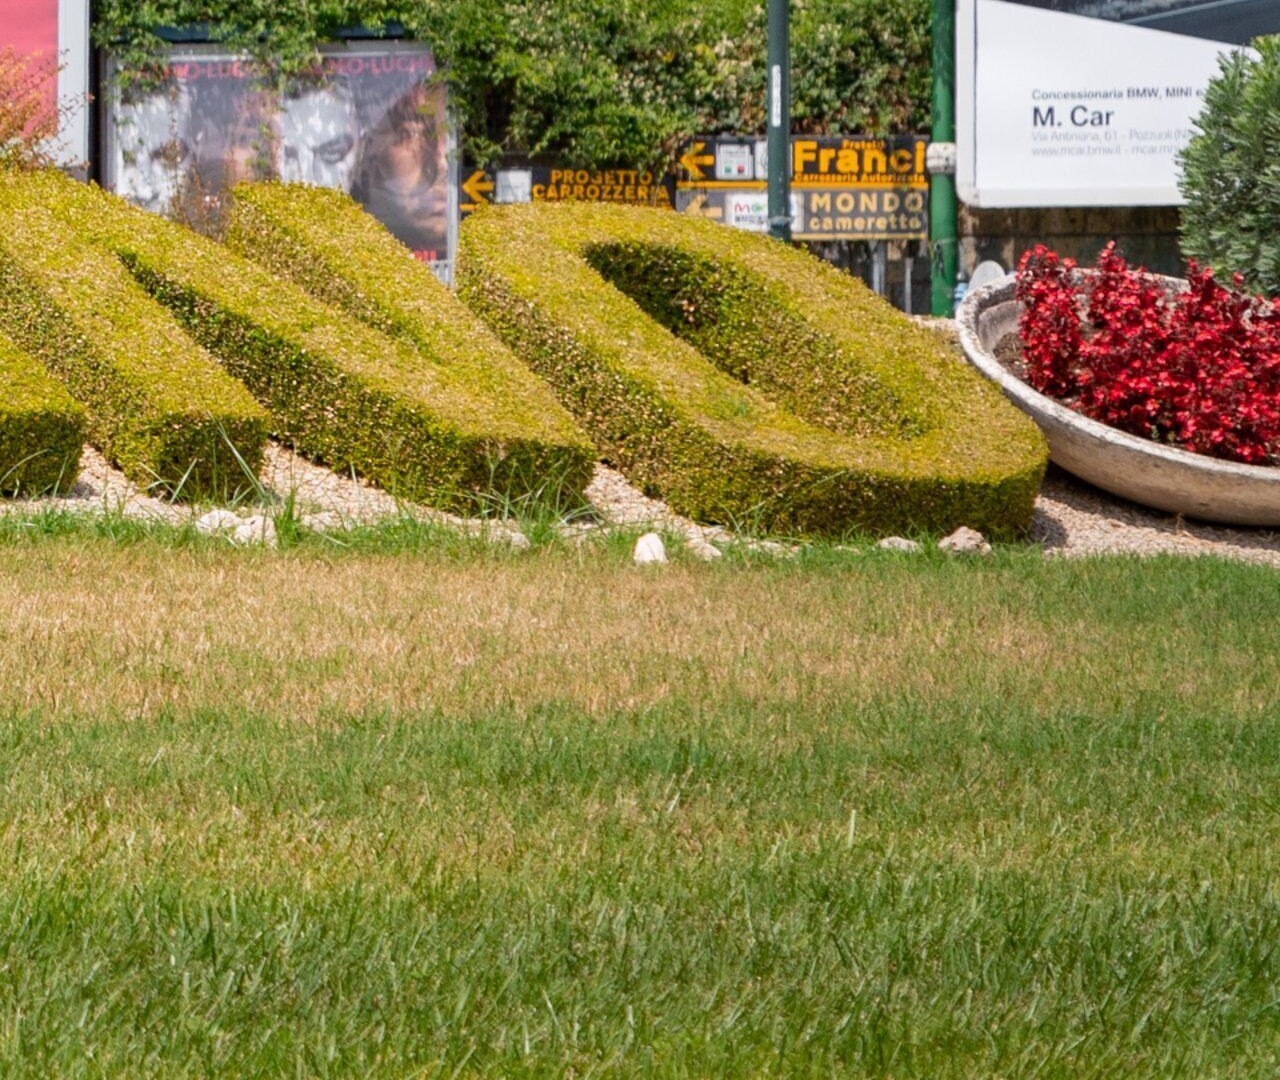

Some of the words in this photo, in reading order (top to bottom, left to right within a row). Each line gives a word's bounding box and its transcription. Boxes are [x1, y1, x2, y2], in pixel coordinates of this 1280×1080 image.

[1031, 88, 1124, 101] Concessionaria
[1126, 87, 1163, 100] BMW,
[1165, 87, 1193, 99] MINI
[1032, 106, 1063, 127] M.
[1069, 105, 1115, 127] Car
[1031, 131, 1049, 142] Via
[793, 139, 927, 173] Franci
[550, 169, 654, 185] PROGETTO
[532, 184, 671, 200] CARROZZERIA
[809, 191, 924, 214] MONDO
